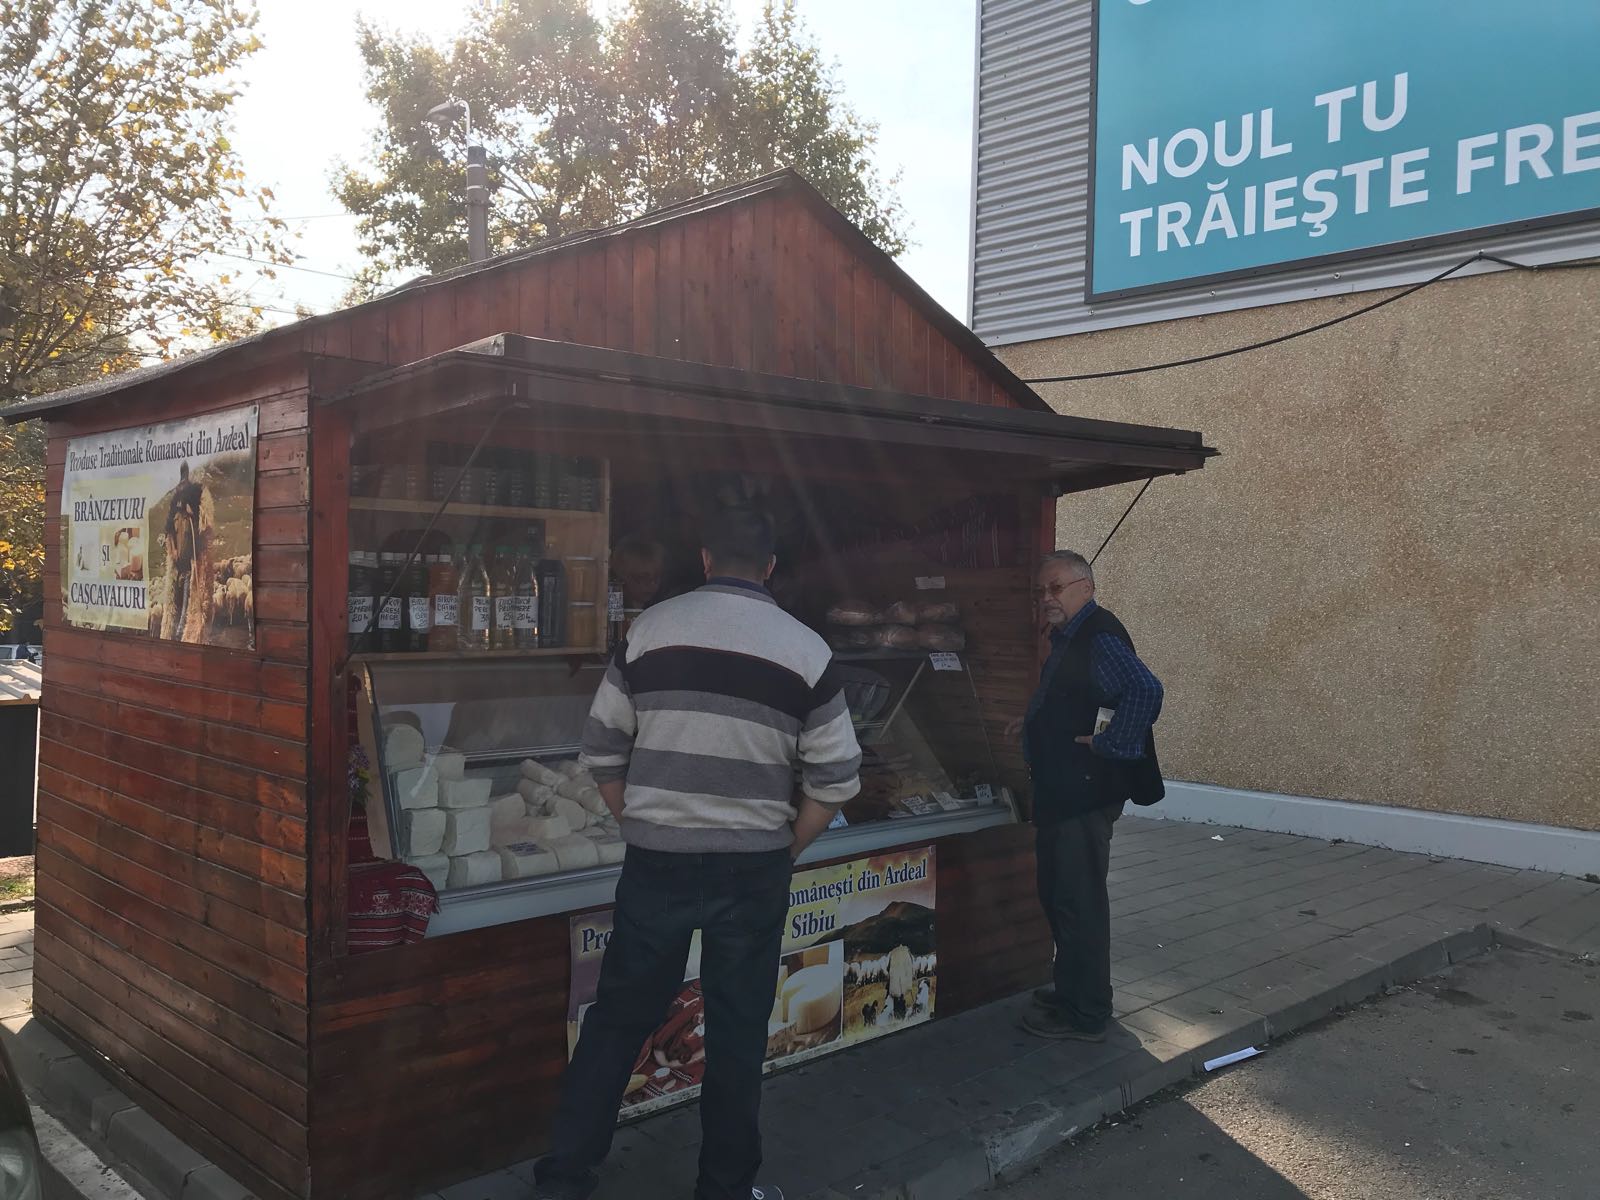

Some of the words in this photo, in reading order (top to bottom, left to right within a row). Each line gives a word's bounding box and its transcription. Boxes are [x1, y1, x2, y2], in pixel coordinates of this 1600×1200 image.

[1121, 108, 1293, 190] NOUL
[1314, 72, 1409, 144] TU
[69, 451, 98, 472] Produse
[195, 430, 213, 457] din
[213, 422, 250, 454] Ardeal
[74, 493, 146, 522] BRÂNZETURI
[71, 582, 147, 610] CAȘCAVALURI
[582, 928, 613, 953] Pro
[789, 874, 853, 907] omânești
[857, 870, 880, 891] din
[884, 858, 927, 885] Ardeal
[791, 909, 836, 939] Sibiu
